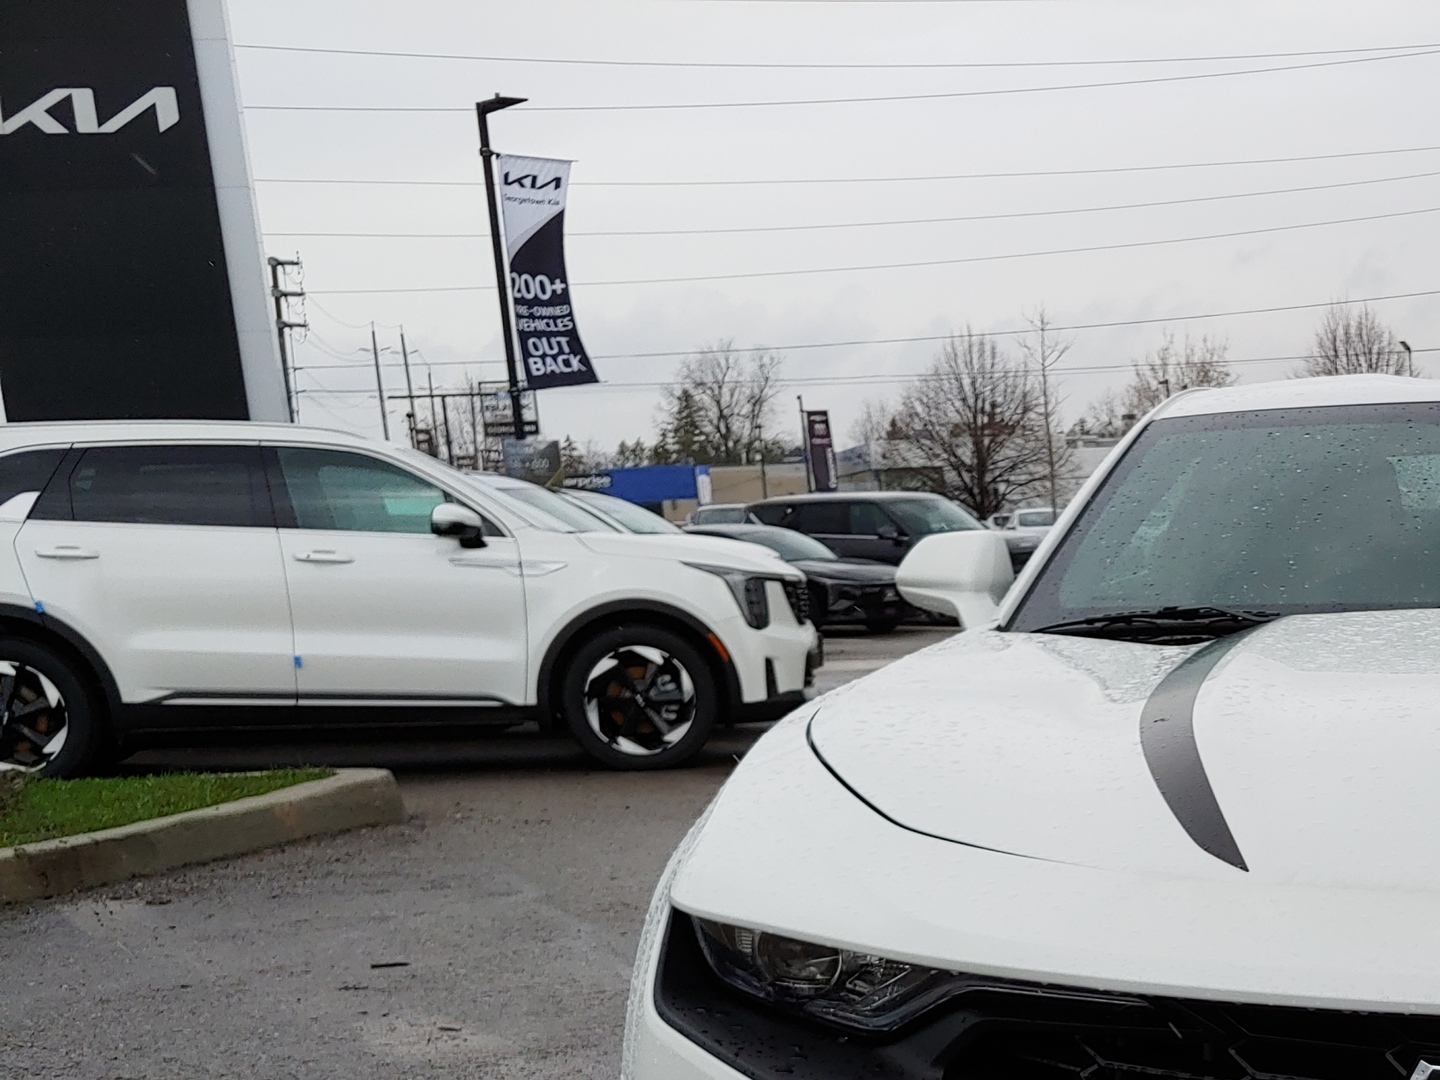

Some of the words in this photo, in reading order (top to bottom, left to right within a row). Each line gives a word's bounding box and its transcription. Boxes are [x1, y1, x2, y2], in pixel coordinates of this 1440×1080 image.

[0, 86, 180, 134] KIA
[503, 171, 561, 190] KIA
[511, 271, 567, 300] 200+
[527, 336, 571, 356] OUT
[527, 354, 588, 376] BACK
[562, 474, 612, 488] erprise
